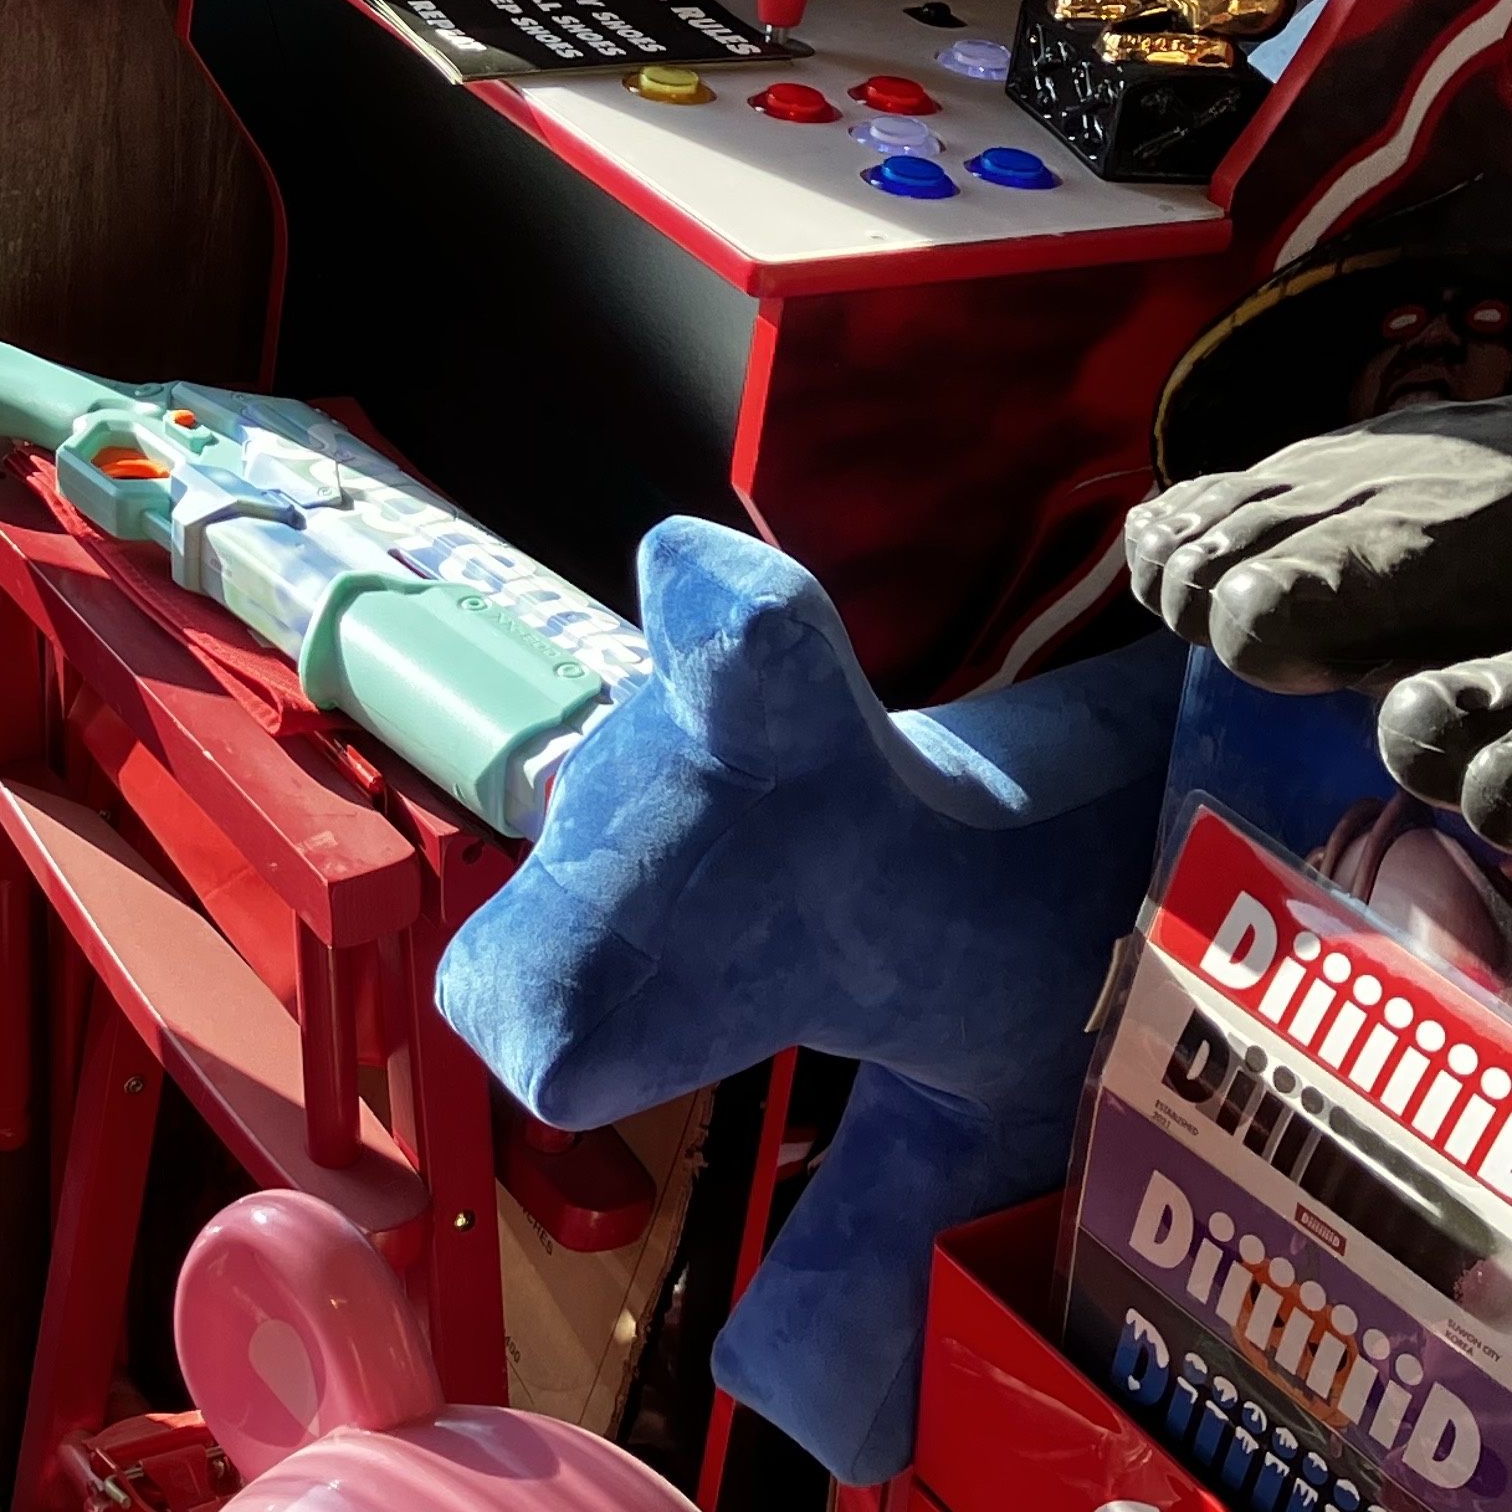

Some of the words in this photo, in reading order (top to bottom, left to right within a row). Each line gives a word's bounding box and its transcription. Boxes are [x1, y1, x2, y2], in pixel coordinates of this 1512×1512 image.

[407, 0, 487, 52] REPEAT
[510, 17, 584, 60] SHOES
[550, 15, 627, 58] SHOES
[591, 11, 667, 54] SHOES
[670, 6, 762, 56] RULES
